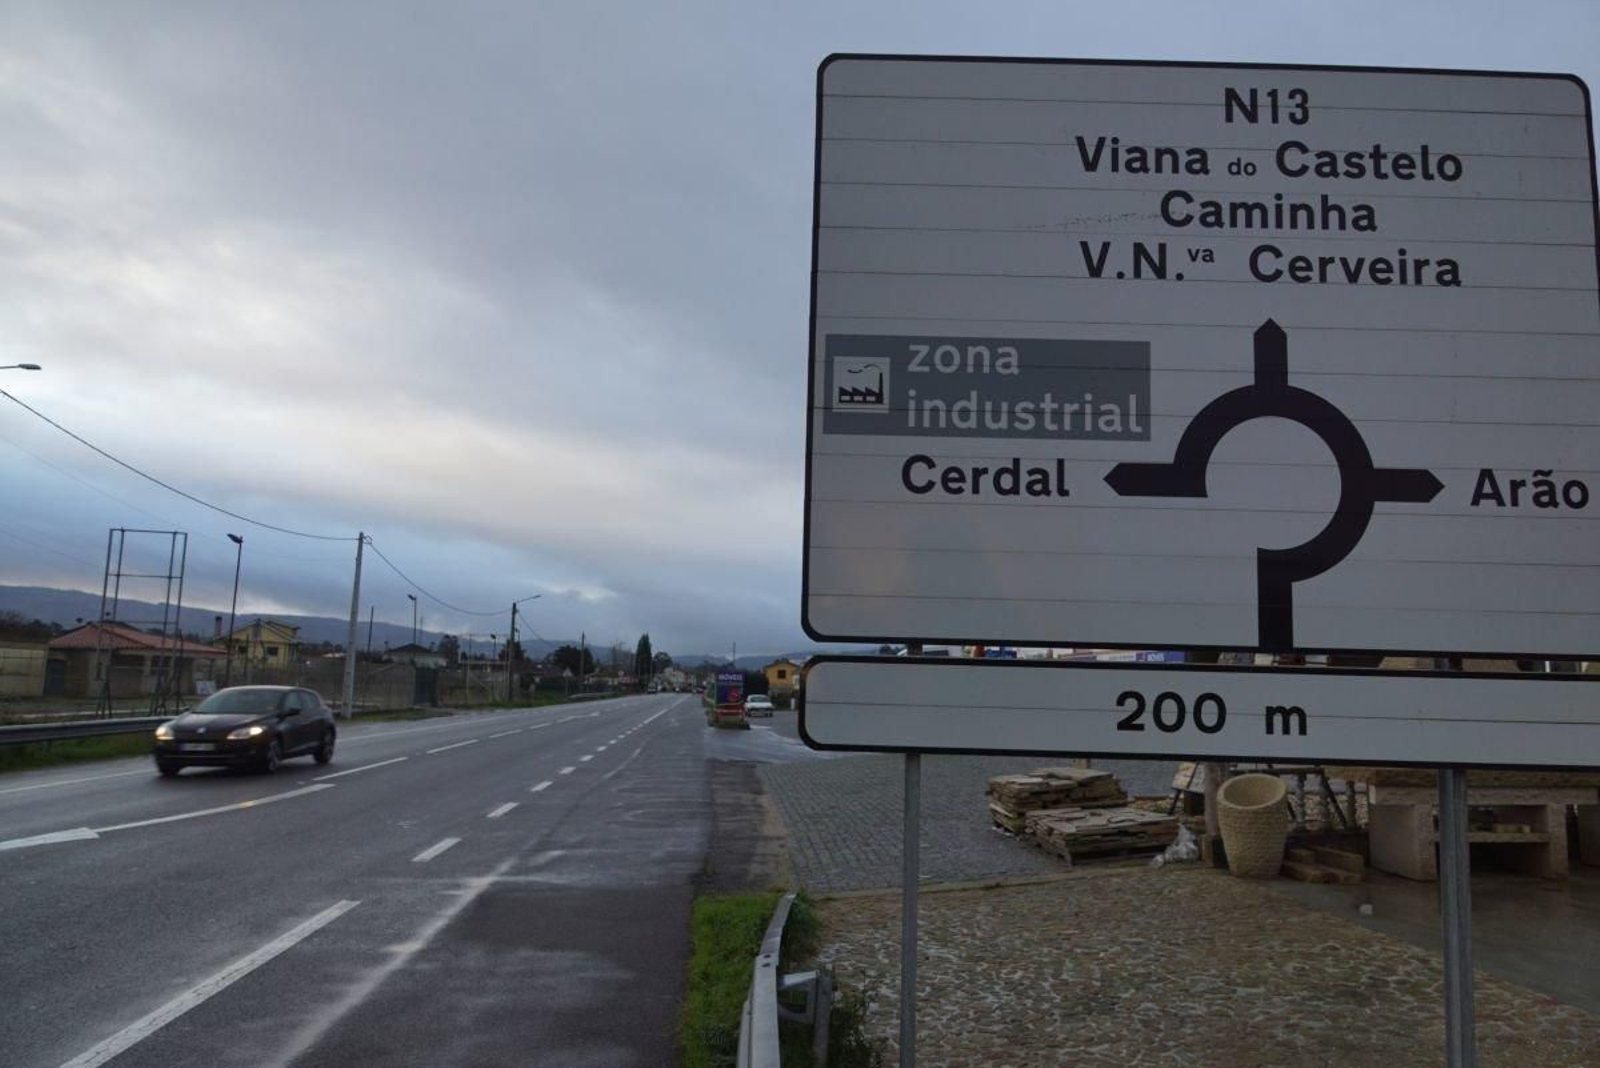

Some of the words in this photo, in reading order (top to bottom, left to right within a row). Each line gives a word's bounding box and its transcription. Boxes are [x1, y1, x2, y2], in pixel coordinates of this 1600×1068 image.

[1224, 87, 1310, 126] N13
[1075, 136, 1210, 176] Viana
[1227, 157, 1257, 177] do
[1275, 140, 1463, 182] Castelo
[1160, 189, 1378, 232] Caminha
[1249, 244, 1462, 288] Cerveira
[907, 343, 1020, 375] zona
[907, 389, 1143, 433] industrial
[901, 454, 1070, 497] Cerdal
[1470, 468, 1589, 510] Arão
[1116, 690, 1227, 734] 200
[1264, 705, 1307, 736] m
